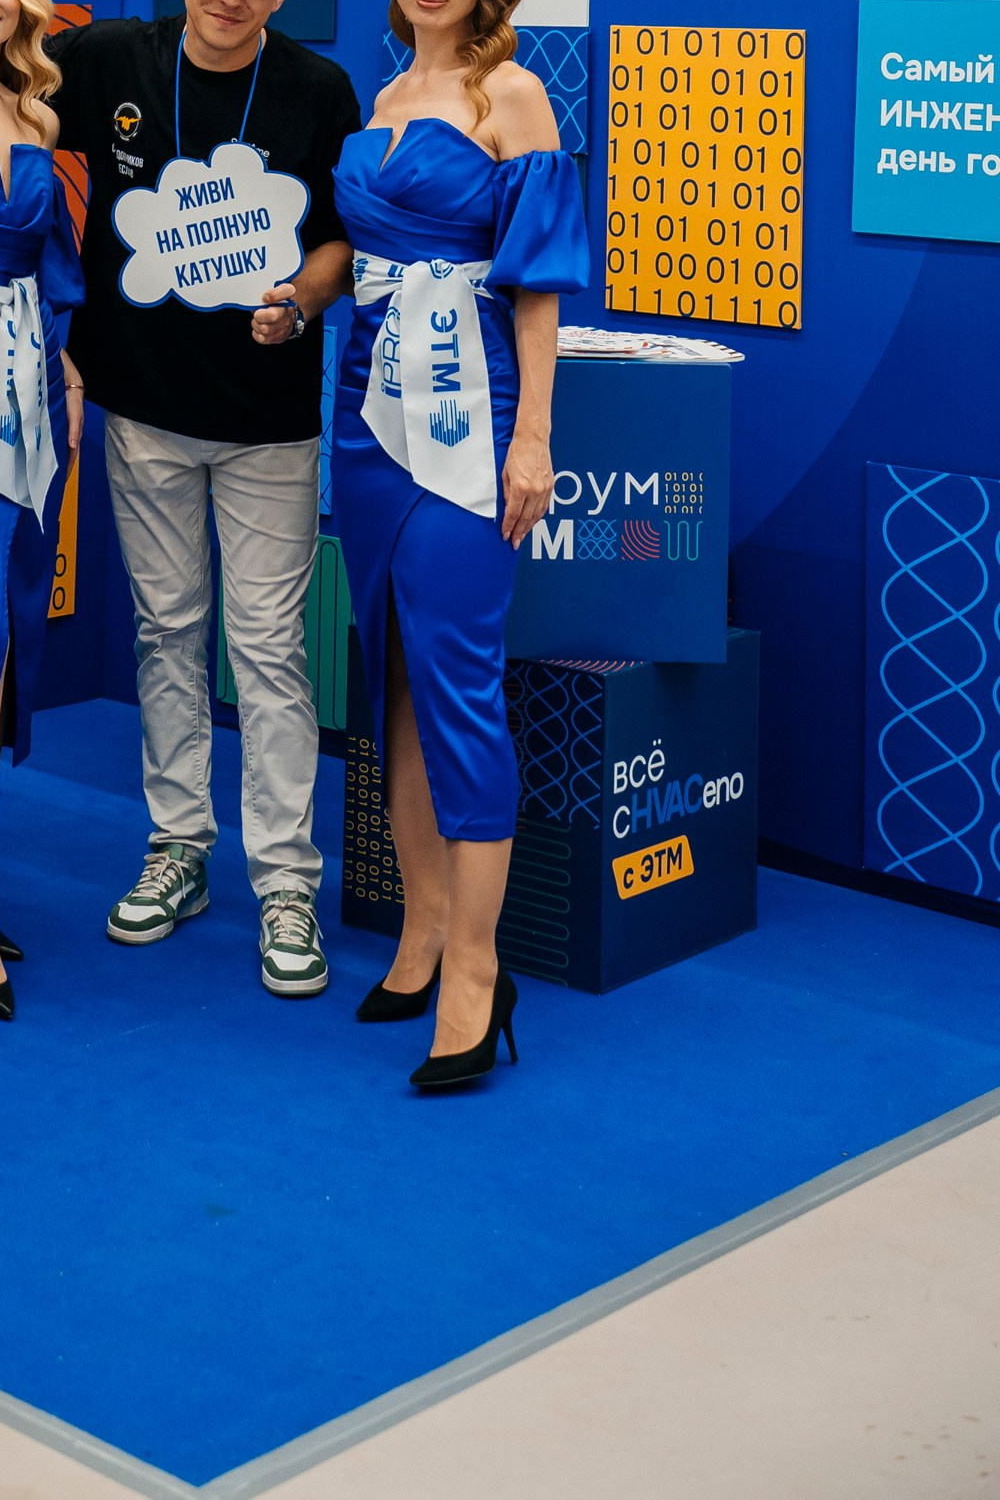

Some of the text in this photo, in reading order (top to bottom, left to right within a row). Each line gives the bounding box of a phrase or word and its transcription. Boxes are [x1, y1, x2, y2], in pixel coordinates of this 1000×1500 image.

[880, 52, 995, 84] Самый
[876, 148, 1000, 177] день го
[174, 176, 235, 212] ЖИВИ
[155, 207, 271, 254] НА ПОЛНУЮ
[174, 245, 266, 288] КАТУШКУ
[430, 308, 462, 393] ЭТМ
[549, 470, 660, 515] рум
[640, 842, 683, 883] ЭТМ
